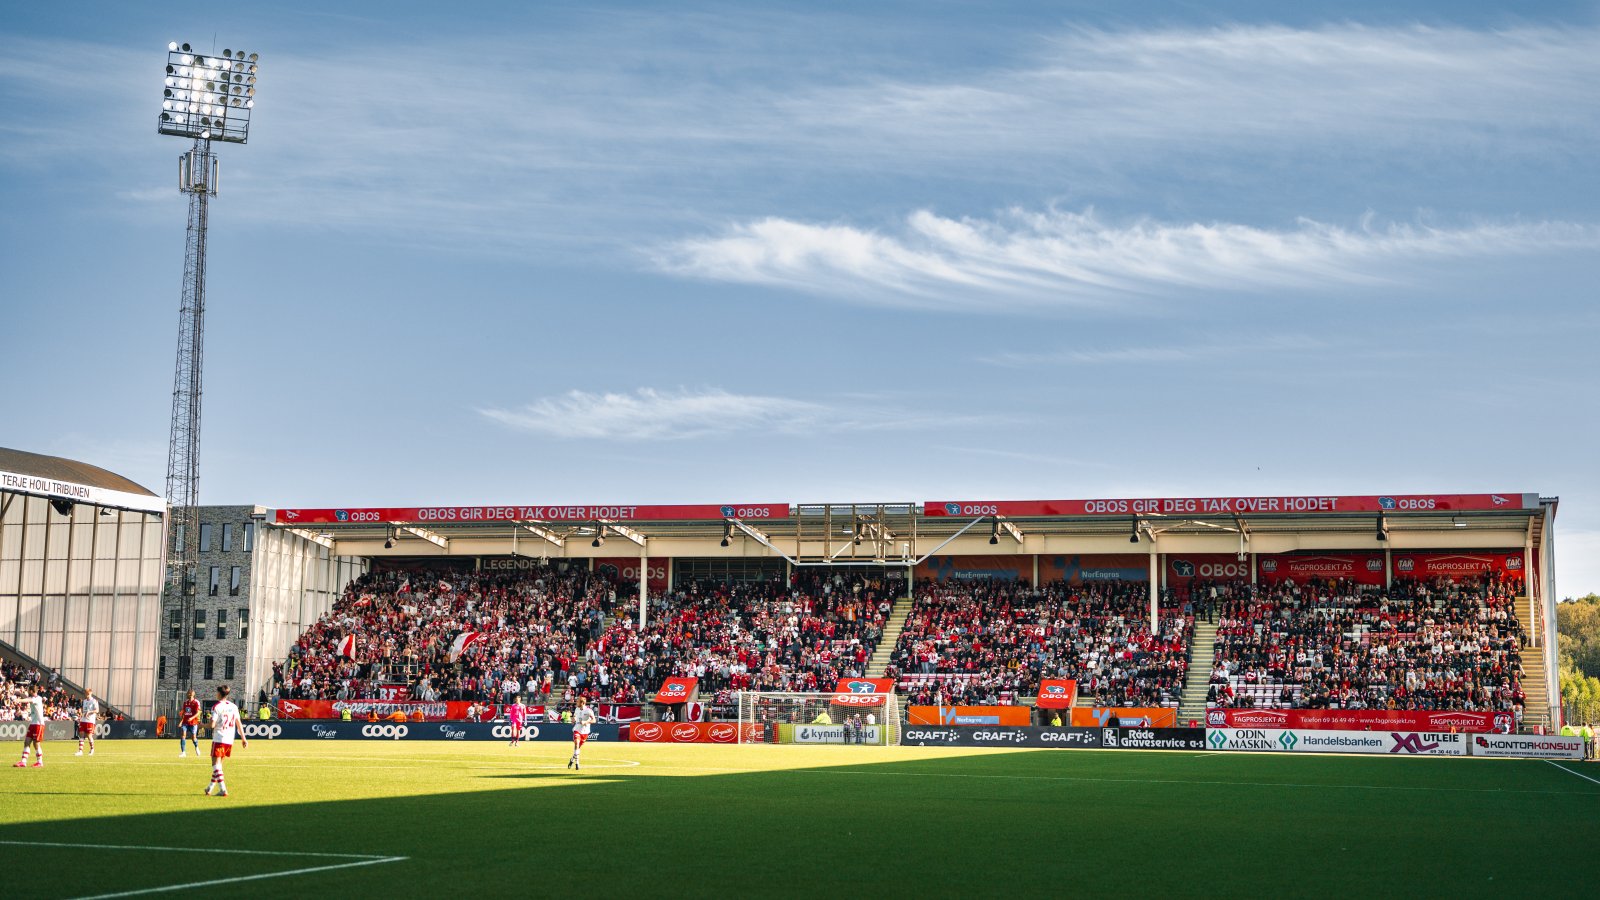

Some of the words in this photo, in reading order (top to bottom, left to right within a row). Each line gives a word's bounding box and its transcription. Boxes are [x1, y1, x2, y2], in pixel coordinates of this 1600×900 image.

[2, 474, 27, 488] TERJE
[29, 479, 51, 492] HOILI
[52, 482, 90, 498] TRIBUNEN
[1084, 500, 1128, 513] OBOS
[1132, 500, 1159, 513] GIR
[1163, 499, 1196, 512] DEG
[1200, 499, 1231, 511] TAK
[1235, 498, 1280, 511] OVER
[1284, 497, 1338, 510] HODET
[1399, 499, 1436, 509] OBOS
[418, 508, 456, 520] OBOS
[460, 508, 483, 520] GIR
[487, 507, 515, 519] DEG
[518, 507, 544, 519] TAK
[548, 507, 586, 519] OVER
[589, 506, 637, 519] HODET
[737, 508, 770, 518] OBOS
[963, 505, 997, 515] OBOS
[351, 512, 380, 521] OBOS
[622, 567, 665, 580] OBOS
[1082, 570, 1119, 579] NorEngros
[1200, 563, 1248, 577] OBOS
[837, 695, 879, 703] OBOS
[1209, 712, 1224, 721] TAK
[0, 724, 27, 740] oop
[361, 724, 409, 740] coop
[491, 725, 540, 741] coop
[811, 728, 874, 740] kynninsud
[906, 731, 948, 740] CRAFT
[973, 731, 1015, 741] CRAFT
[1040, 732, 1083, 742] CRAFT
[1128, 729, 1154, 739] Råde
[1236, 729, 1266, 739] ODIN
[1303, 735, 1383, 747] Handelsbanken
[1424, 733, 1459, 742] UTLEIE
[1121, 738, 1185, 748] Graveservice
[1228, 739, 1271, 749] MASKIN
[1490, 741, 1581, 751] KONTORKONSULT
